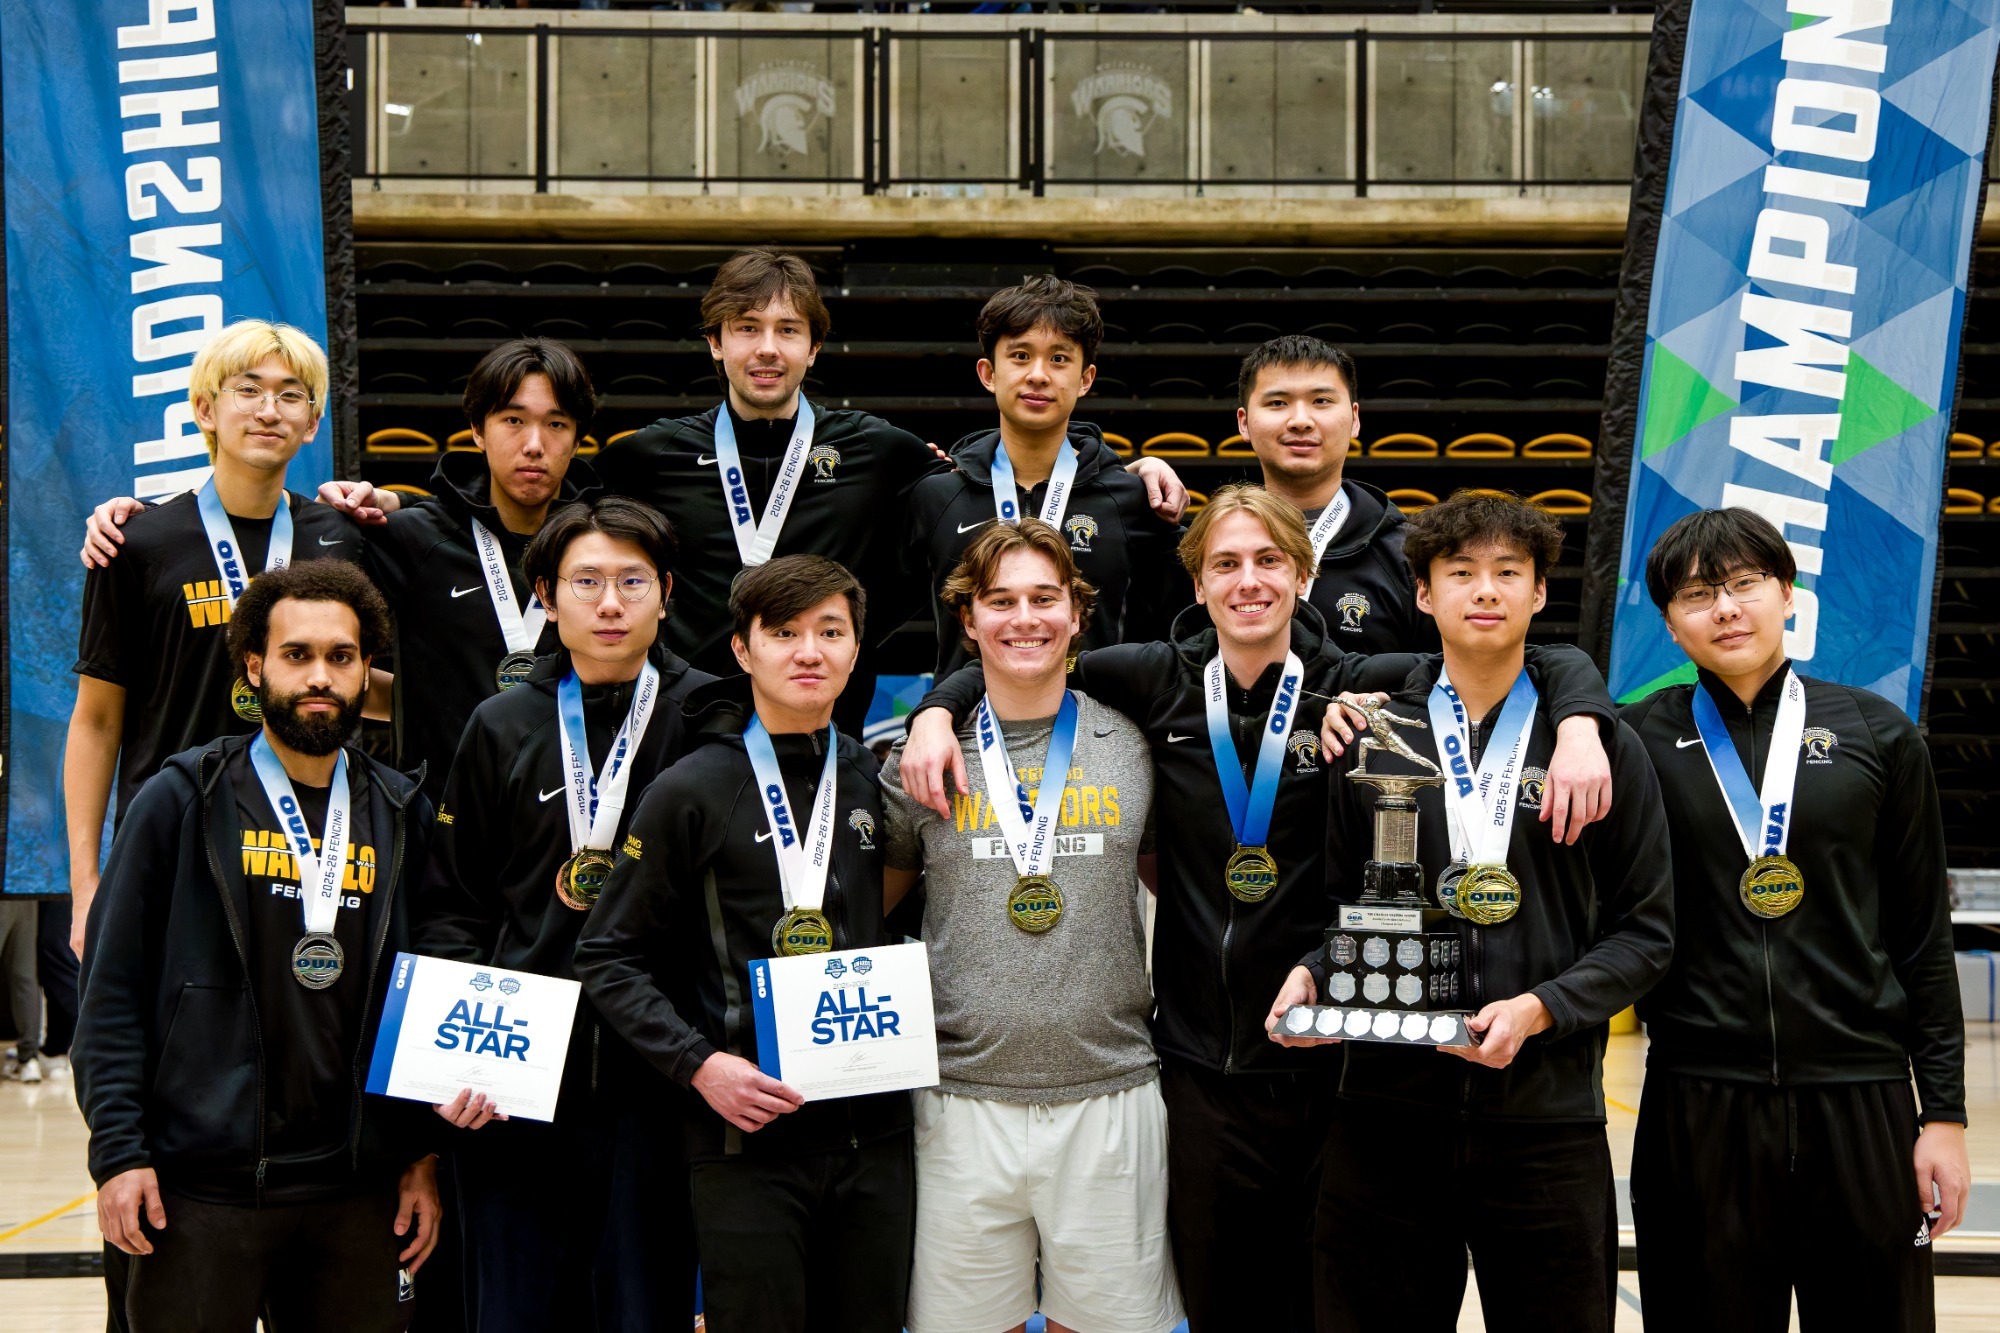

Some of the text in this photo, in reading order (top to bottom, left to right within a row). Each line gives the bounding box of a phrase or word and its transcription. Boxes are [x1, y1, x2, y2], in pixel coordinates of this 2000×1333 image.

[770, 437, 804, 518] 2025-26 FENCING
[726, 466, 751, 526] OUA
[1046, 481, 1064, 521] FENCING
[1322, 500, 1344, 533] FENCING
[217, 540, 245, 600] OUA
[489, 564, 508, 602] 2025-26
[500, 674, 527, 683] OU
[637, 675, 655, 718] FENCING
[1788, 676, 1798, 702] 2025-
[1270, 675, 1298, 735] OUA
[1443, 734, 1474, 799] OUA
[765, 783, 795, 849] OUA
[1493, 782, 1511, 827] 2025-26
[278, 795, 312, 857] OUA
[813, 779, 832, 867] 2025-26 FENCING
[1030, 815, 1049, 862] FENCING
[321, 808, 343, 898] 2025-26 FENCING
[575, 874, 606, 884] OU
[1230, 873, 1273, 883] OUA
[1751, 882, 1799, 895] OUA
[1013, 901, 1057, 912] OUA
[1470, 892, 1516, 902] OUA
[788, 935, 828, 945] OUA
[297, 958, 339, 969] OUA
[396, 959, 410, 989] OUA
[755, 965, 767, 999] OUA
[444, 999, 528, 1032] ALL-
[814, 987, 891, 1018] ALL-
[434, 1023, 530, 1062] STAR
[811, 1010, 900, 1045] STAR
